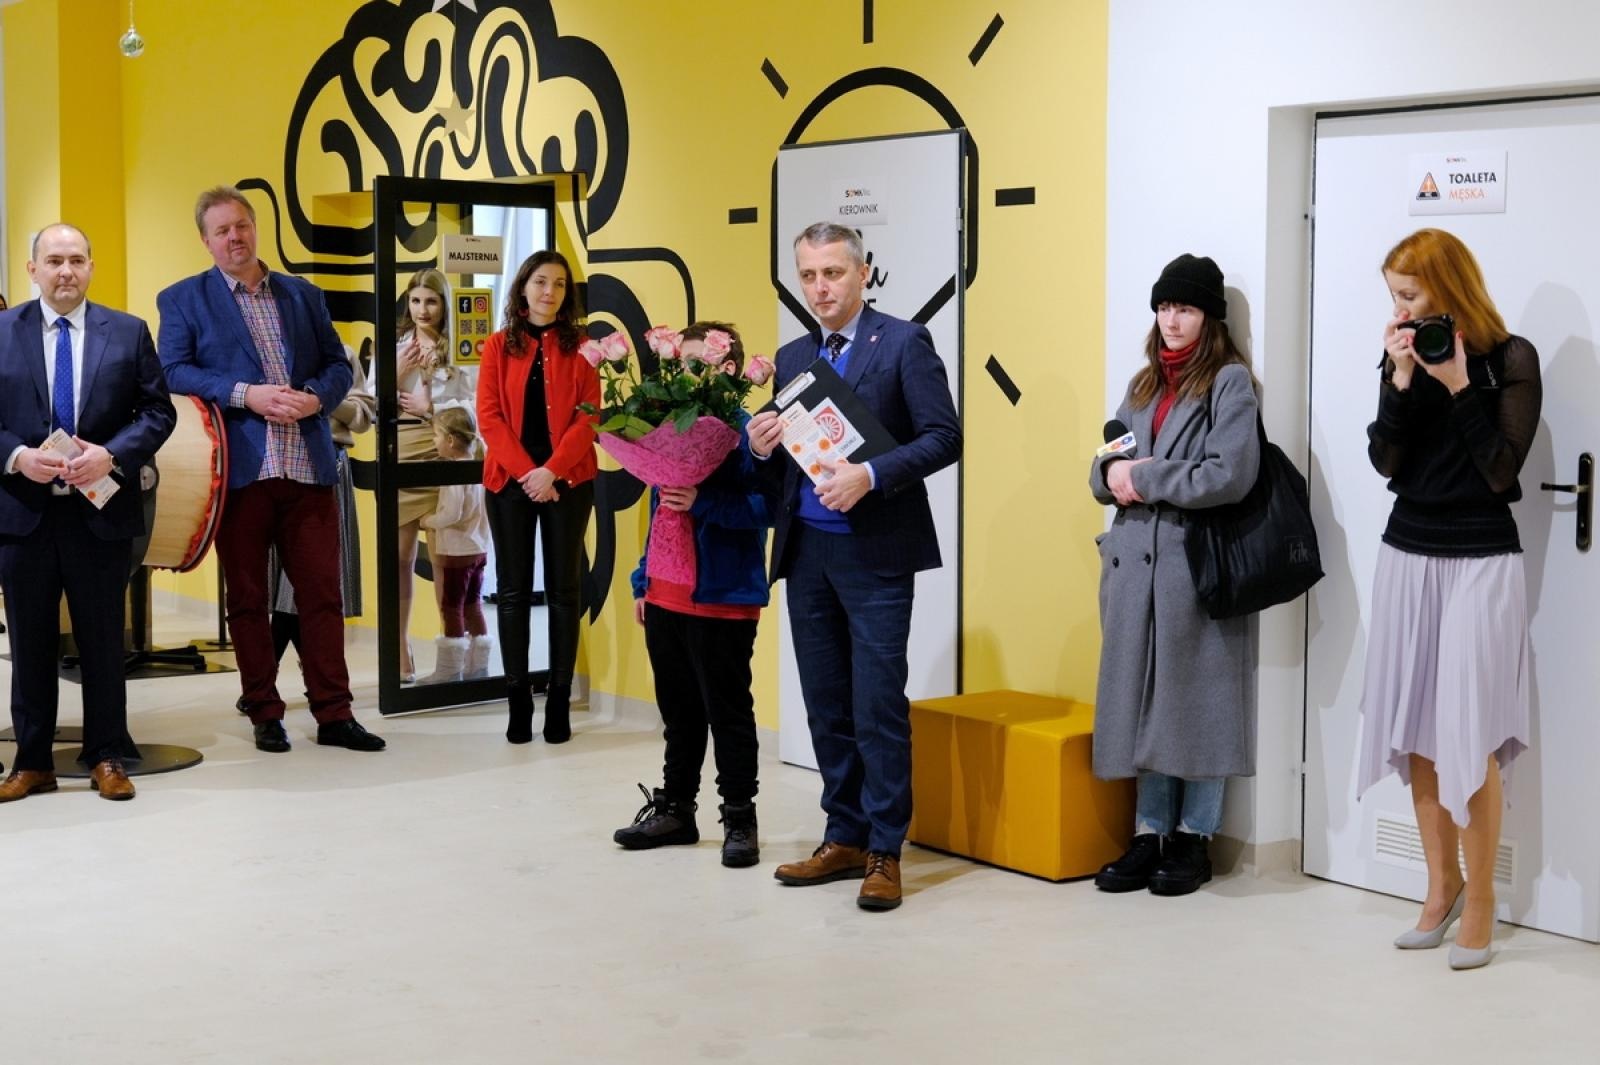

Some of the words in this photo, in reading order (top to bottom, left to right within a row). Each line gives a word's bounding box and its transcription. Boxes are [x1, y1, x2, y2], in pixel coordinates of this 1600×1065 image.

[1449, 172, 1497, 184] TOALETA
[1449, 187, 1485, 203] MĘSKA
[839, 203, 878, 215] KIEROWNIK
[448, 251, 500, 262] MAJSTERNIA
